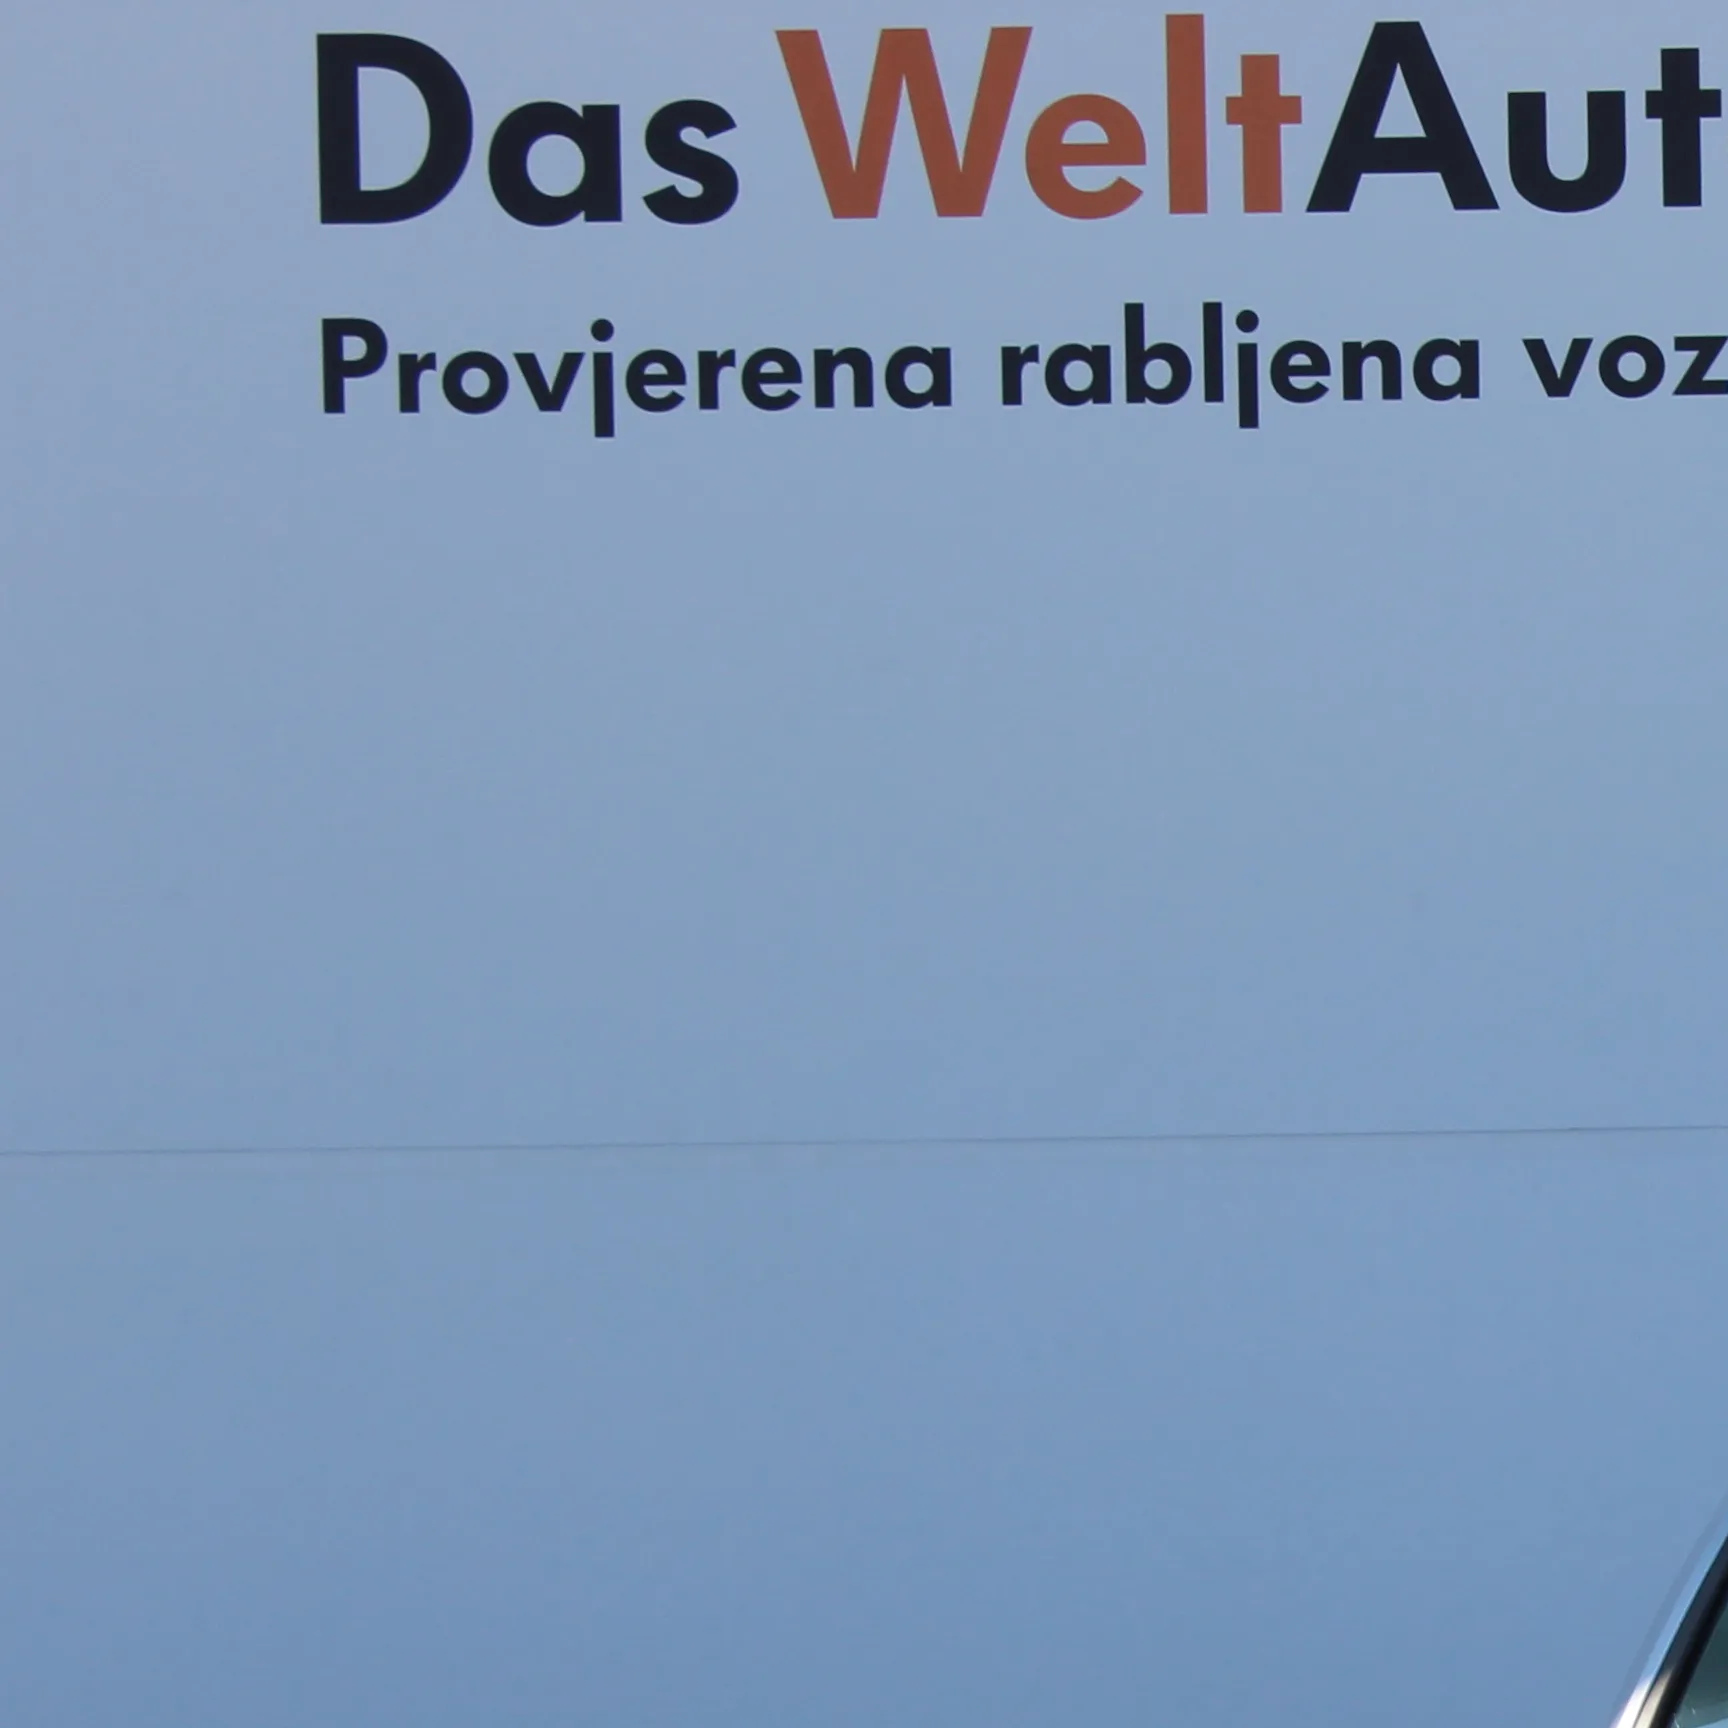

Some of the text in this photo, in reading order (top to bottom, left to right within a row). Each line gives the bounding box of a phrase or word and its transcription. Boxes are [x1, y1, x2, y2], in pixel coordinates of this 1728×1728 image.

[317, 33, 738, 226] Das
[322, 318, 951, 437] Provjerena
[1001, 302, 1479, 428] rabljena
